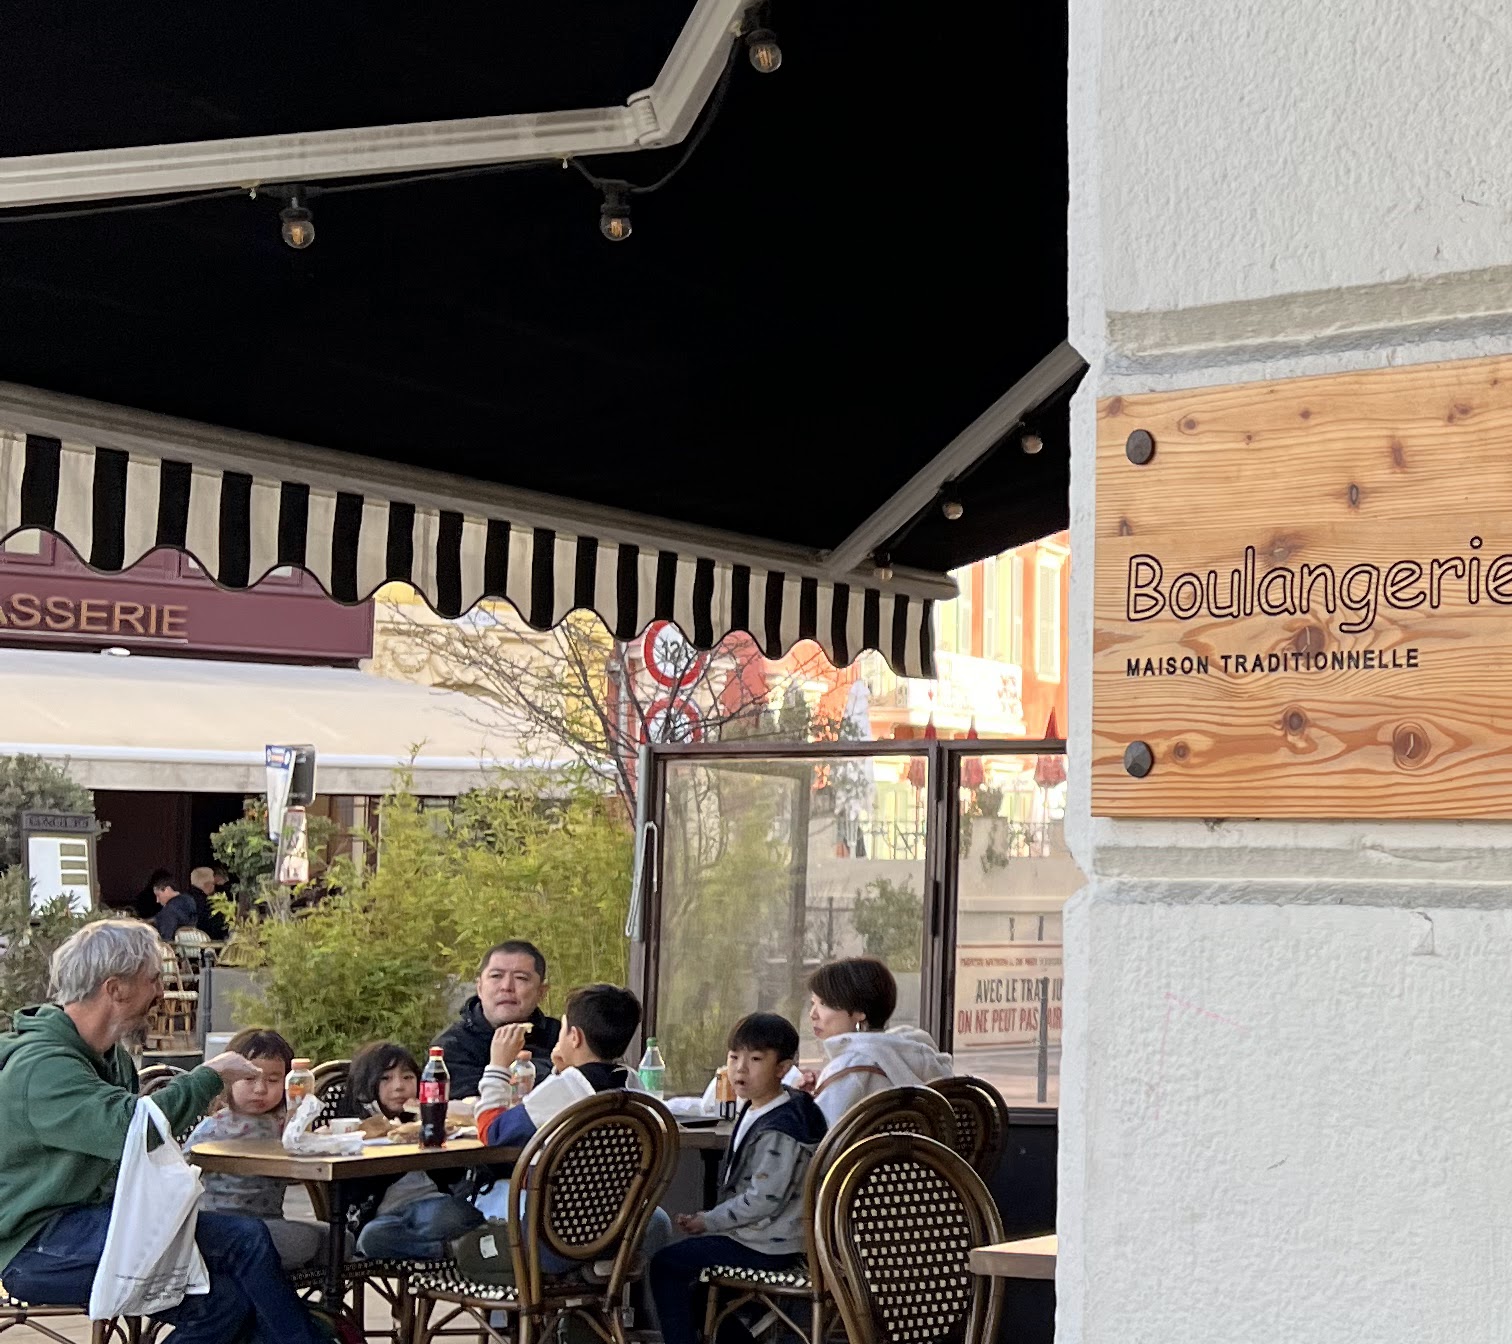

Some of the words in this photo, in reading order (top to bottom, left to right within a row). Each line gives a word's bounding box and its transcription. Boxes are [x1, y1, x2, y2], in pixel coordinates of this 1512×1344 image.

[0, 592, 190, 637] SSERIE
[1126, 654, 1210, 677] MAISON
[1220, 647, 1420, 675] TRADITIONNELLE
[976, 979, 1003, 1004] AVEC
[1006, 979, 1018, 1002] LE
[958, 1010, 972, 1034] ON
[976, 1009, 989, 1033] NE
[992, 1008, 1017, 1033] PEUT
[1020, 1007, 1039, 1031] PAS
